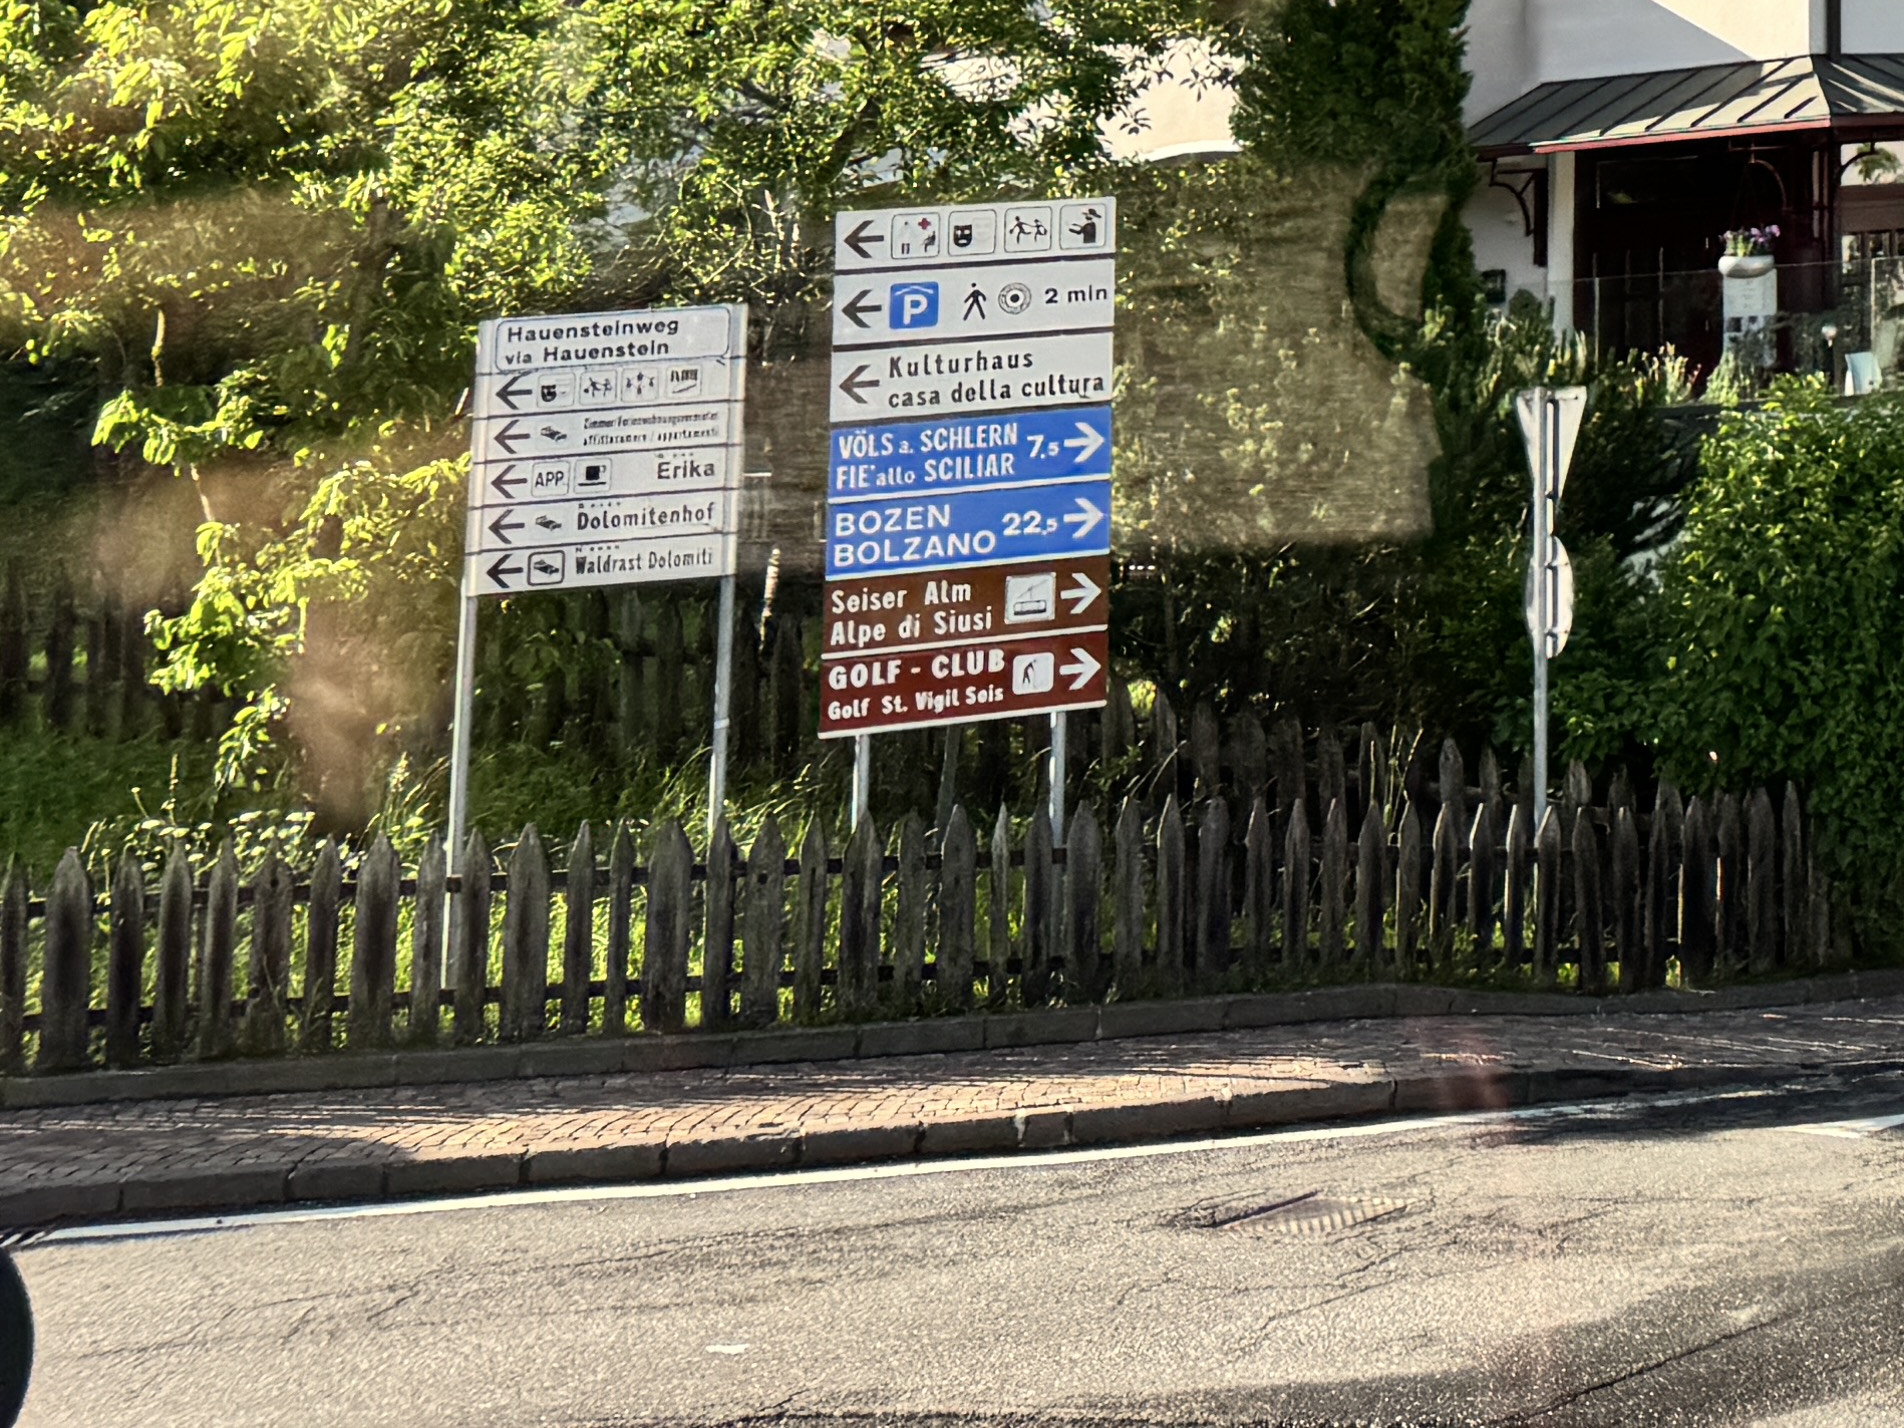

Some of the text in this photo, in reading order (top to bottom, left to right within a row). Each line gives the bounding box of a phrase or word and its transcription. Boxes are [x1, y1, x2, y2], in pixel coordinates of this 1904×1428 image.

[1045, 287, 1059, 304] 2
[1067, 284, 1108, 303] min
[507, 320, 679, 343] Hauensteinweg
[505, 340, 670, 365] via Hauenstein
[889, 350, 1034, 379] Kulturhaus
[888, 374, 1105, 408] casa della cultura
[839, 428, 894, 460] VÖLS
[898, 440, 914, 455] a.
[920, 422, 1019, 453] SCHLERN
[534, 460, 715, 488] APP Erika
[876, 467, 916, 487] allo
[924, 453, 1015, 483] SCILIAR
[577, 501, 716, 531] Dolomitenhof
[835, 504, 950, 537] BOZEN
[575, 546, 713, 575] Waldrast Dolomiti
[833, 530, 996, 568] BOLZANO
[831, 580, 972, 615] Seiser Alm
[830, 605, 993, 648] Alpe di Siusi
[828, 659, 902, 691] GOLF
[931, 648, 1006, 679] CLUB
[827, 697, 871, 721] Golf
[881, 695, 909, 715] St.
[915, 689, 960, 714] Vigil
